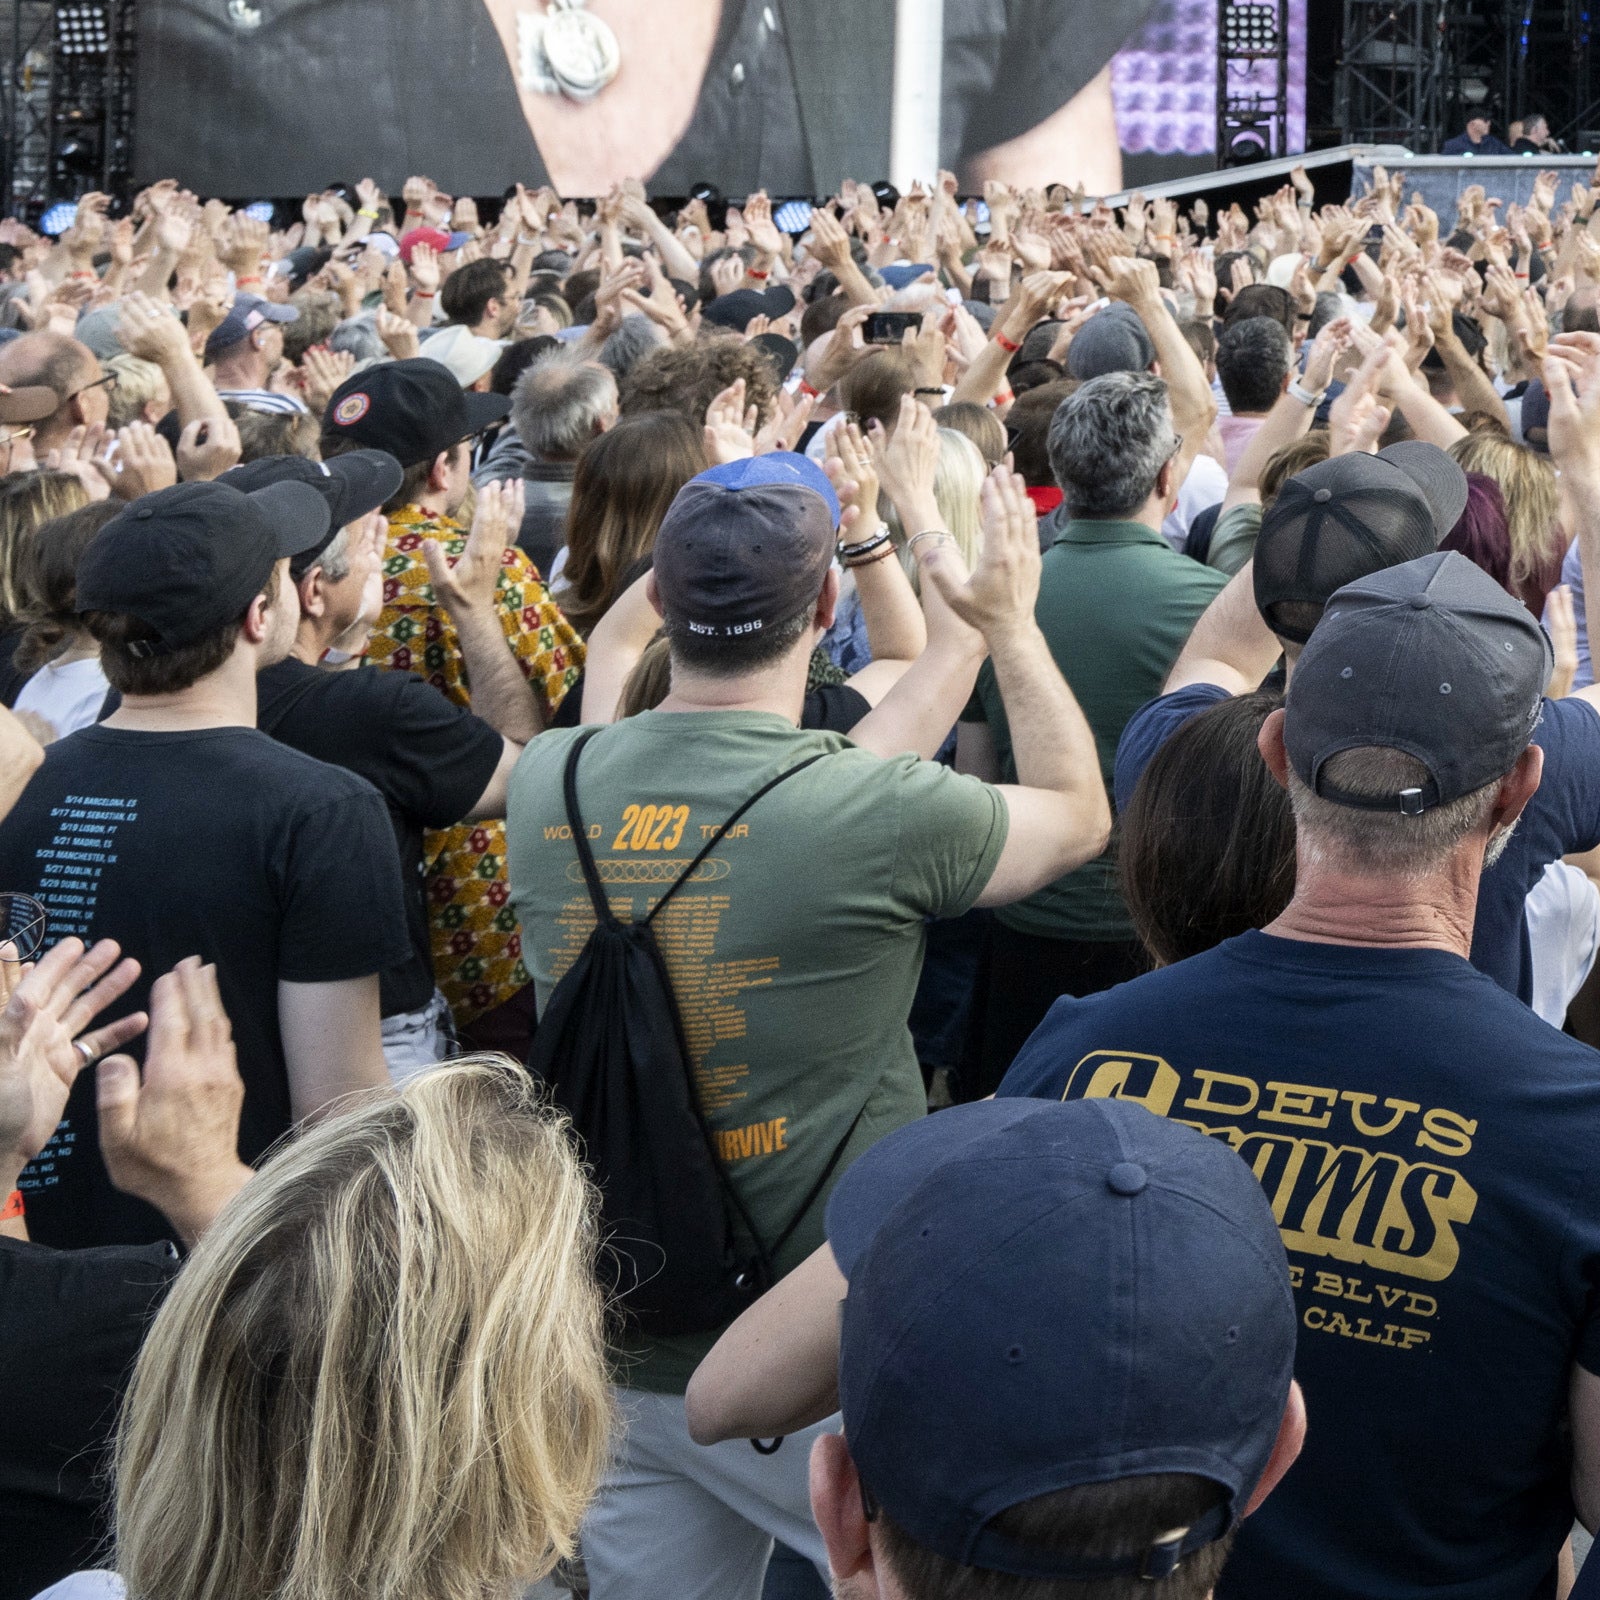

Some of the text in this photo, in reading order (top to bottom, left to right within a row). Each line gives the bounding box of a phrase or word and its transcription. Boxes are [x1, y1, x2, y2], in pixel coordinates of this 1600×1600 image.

[689, 619, 763, 636] EST. 1896
[612, 804, 690, 851] 2023
[108, 855, 118, 863] UK
[1183, 1069, 1478, 1156] DEUS
